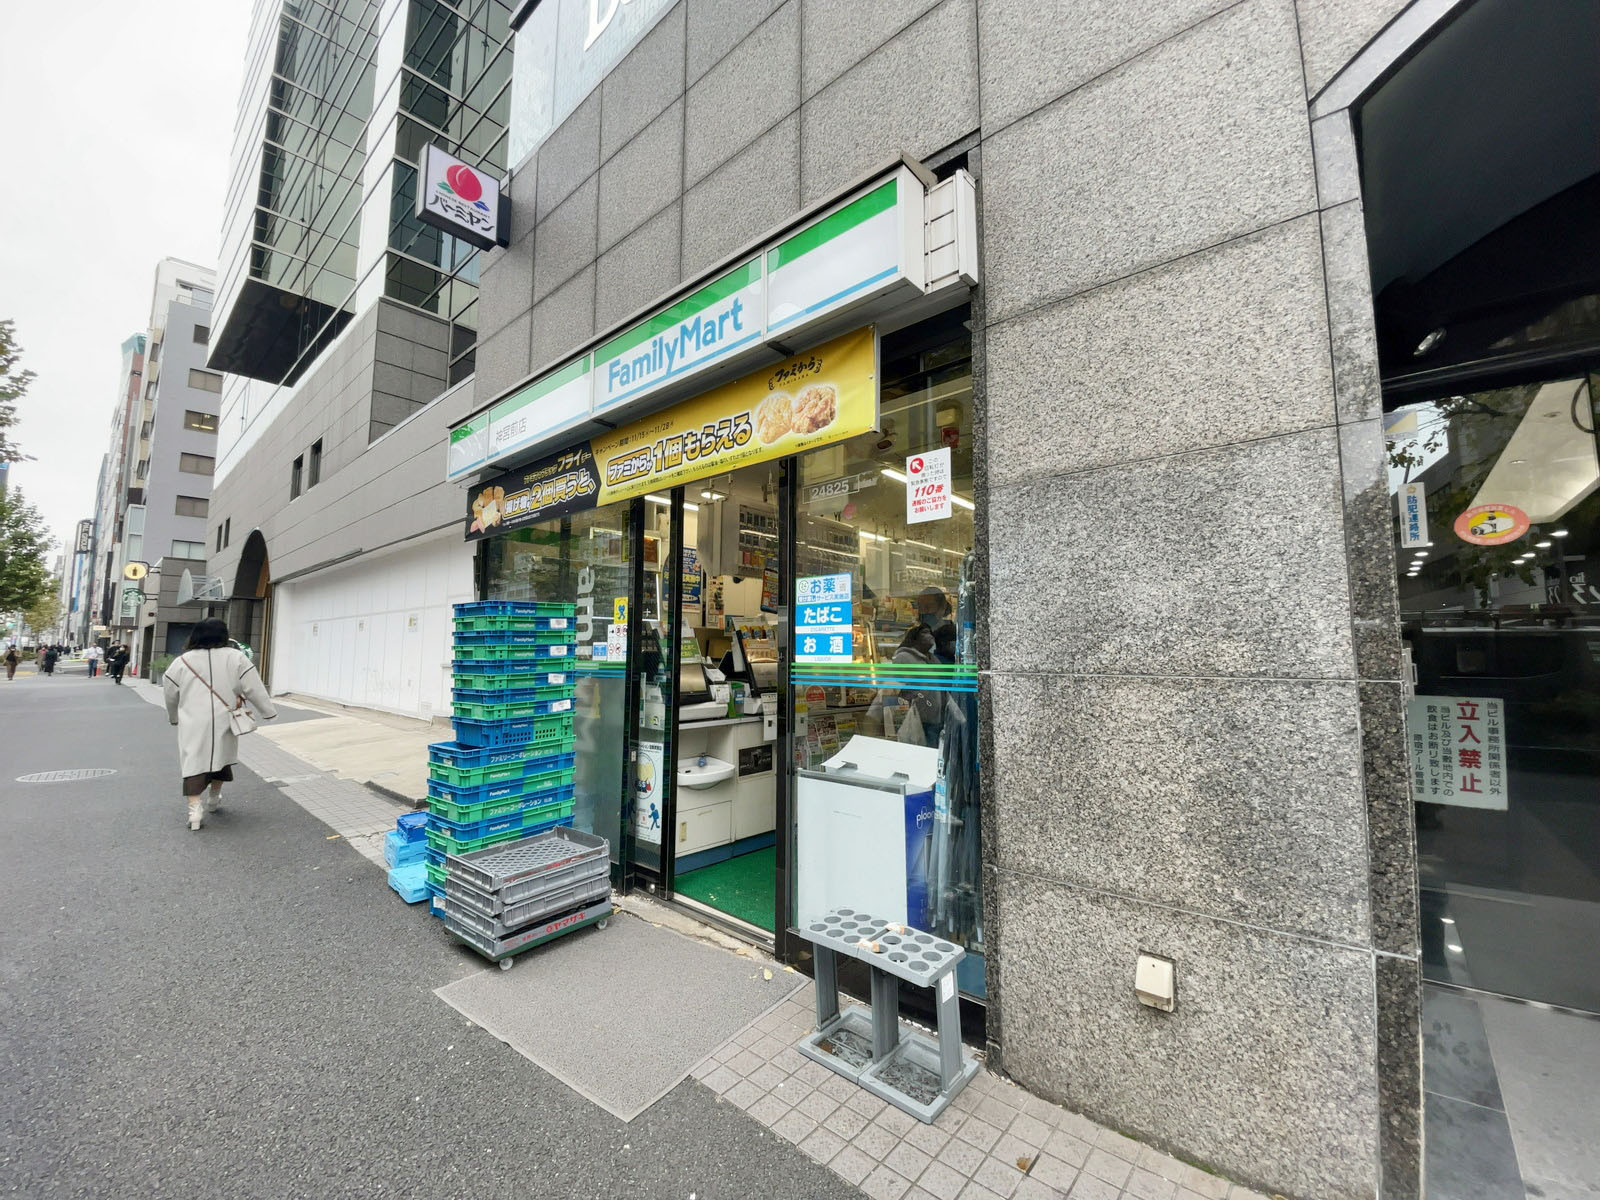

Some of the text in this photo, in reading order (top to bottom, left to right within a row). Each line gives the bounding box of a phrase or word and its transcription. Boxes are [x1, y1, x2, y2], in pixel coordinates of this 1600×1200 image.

[428, 195, 495, 232] バーミヤン
[608, 296, 744, 393] FamilyMart
[495, 416, 528, 444] 神宮前店
[914, 484, 945, 498] 110番
[810, 577, 836, 595] お薬
[803, 606, 843, 624] たばこ
[803, 635, 844, 654] お酒
[1426, 704, 1441, 795] 飲食はお断り致します
[1440, 705, 1454, 797] 当ビル及び当敷地内での
[1456, 700, 1484, 795] 立入禁止
[1486, 701, 1502, 797] 当ビル事務所関係者以外
[489, 788, 510, 797] FamilyMart
[488, 822, 510, 832] FamilyMart
[552, 912, 587, 932] ヤマザキ
